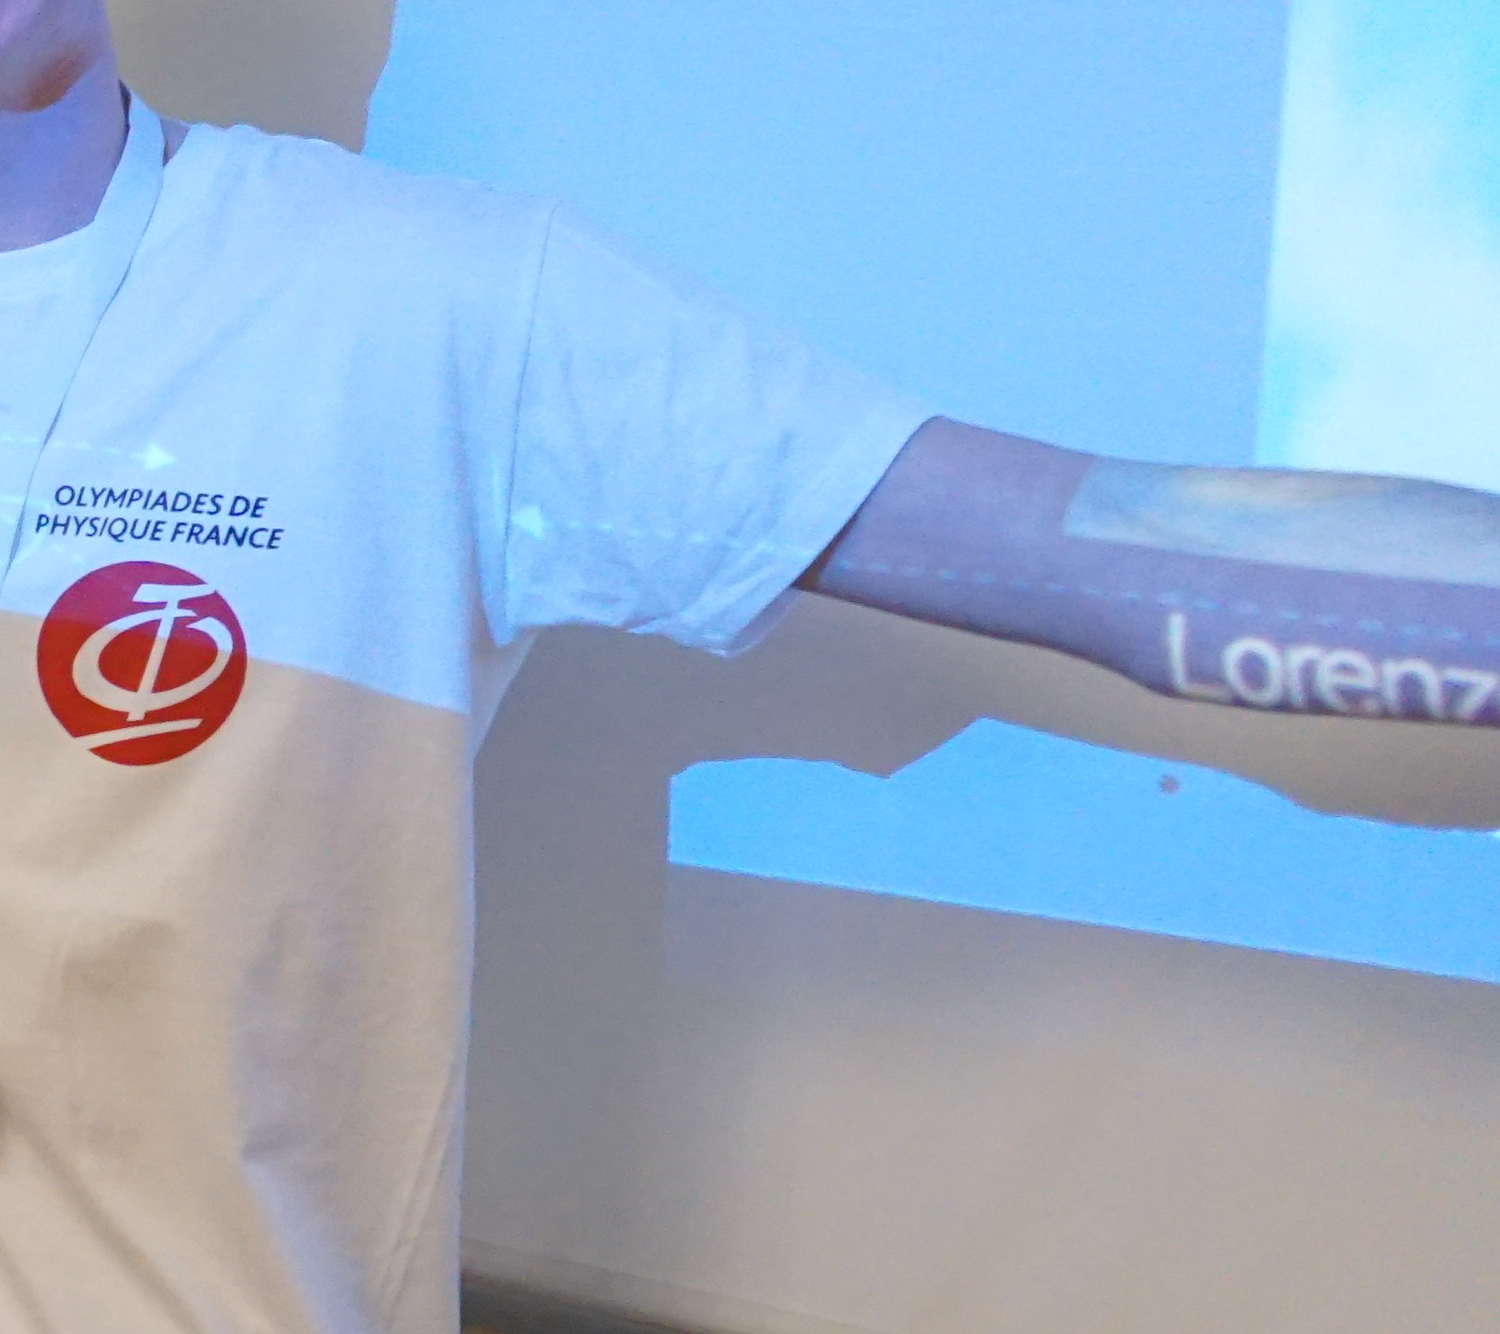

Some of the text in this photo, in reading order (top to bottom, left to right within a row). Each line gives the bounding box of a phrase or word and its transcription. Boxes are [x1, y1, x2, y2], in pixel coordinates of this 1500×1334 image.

[55, 485, 268, 518] OLYMPIADES DE
[35, 514, 285, 550] PHYSIQUE FRANCE
